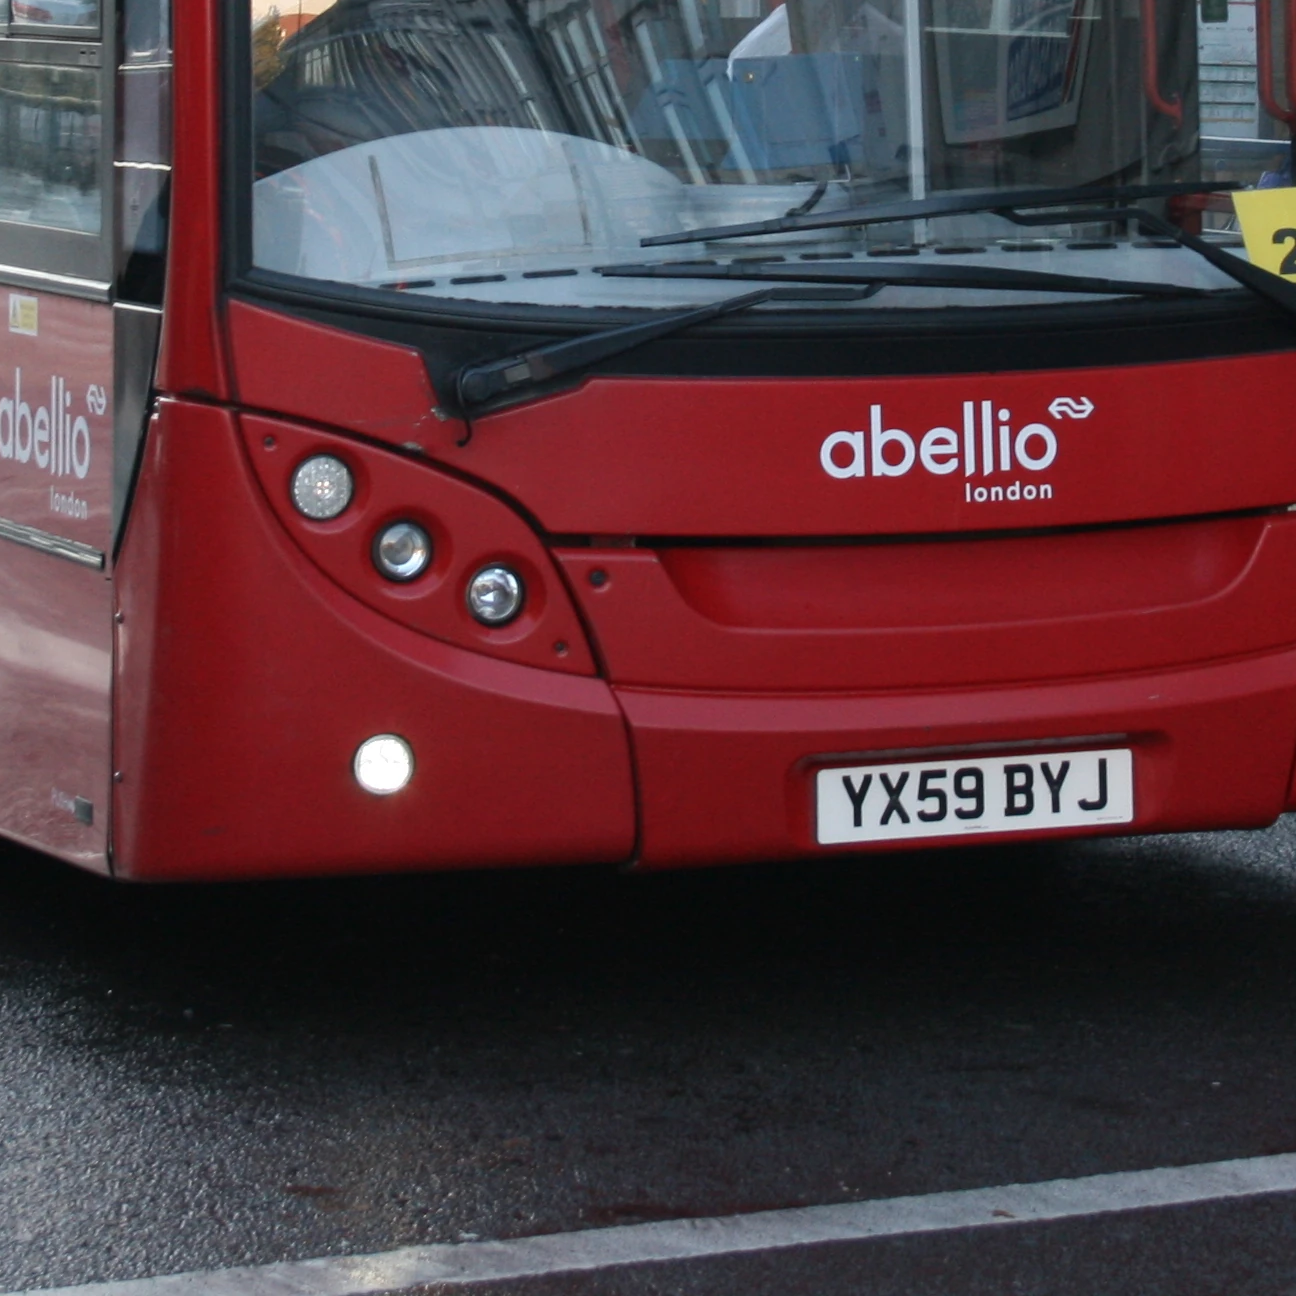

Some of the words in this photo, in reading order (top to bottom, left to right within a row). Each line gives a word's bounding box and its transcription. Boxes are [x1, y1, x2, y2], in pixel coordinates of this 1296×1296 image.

[819, 400, 1057, 479] abellio
[50, 485, 87, 520] london
[965, 481, 1052, 502] london
[842, 767, 984, 827] YX59
[1004, 758, 1108, 817] BYJ
